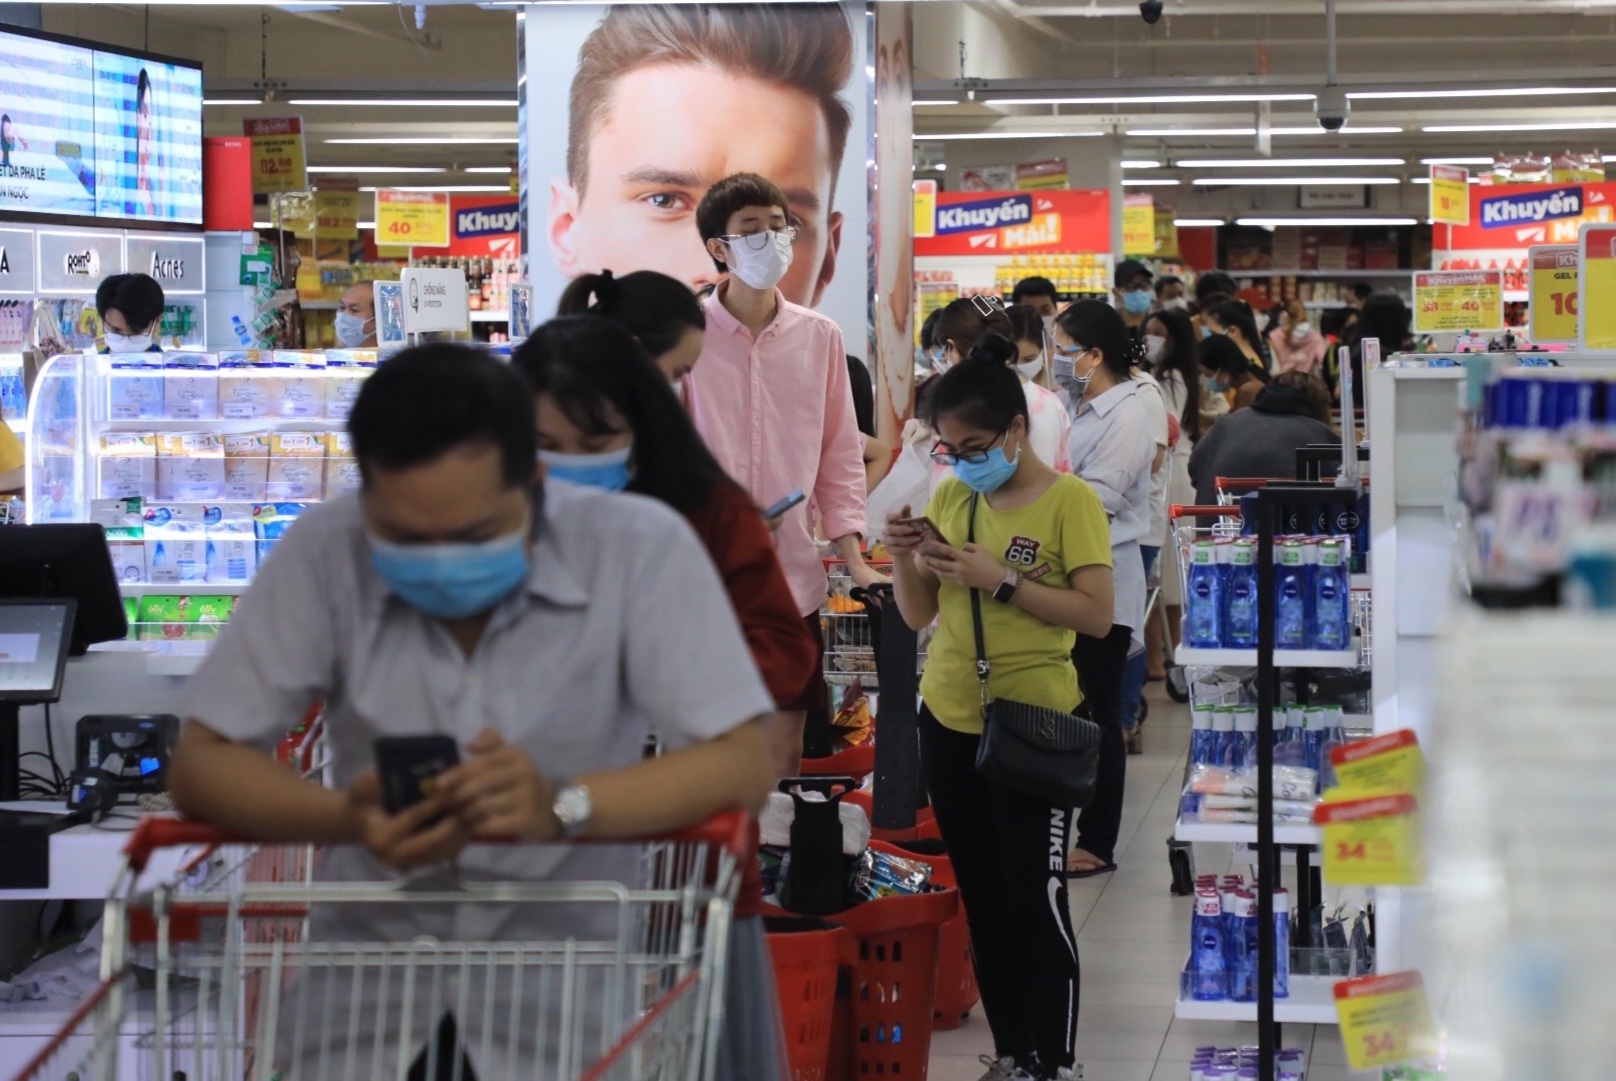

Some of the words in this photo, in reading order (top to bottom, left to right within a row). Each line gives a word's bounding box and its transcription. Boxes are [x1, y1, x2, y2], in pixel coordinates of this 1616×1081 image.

[20, 166, 35, 179] PHA
[938, 198, 1029, 230] Khuyến
[1483, 190, 1579, 223] Khuyến
[389, 221, 411, 234] 40
[153, 252, 184, 279] Acnes
[1554, 272, 1573, 280] GEL
[1016, 538, 1035, 549] WAY
[1008, 545, 1034, 565] 66
[1049, 808, 1064, 872] NIKE
